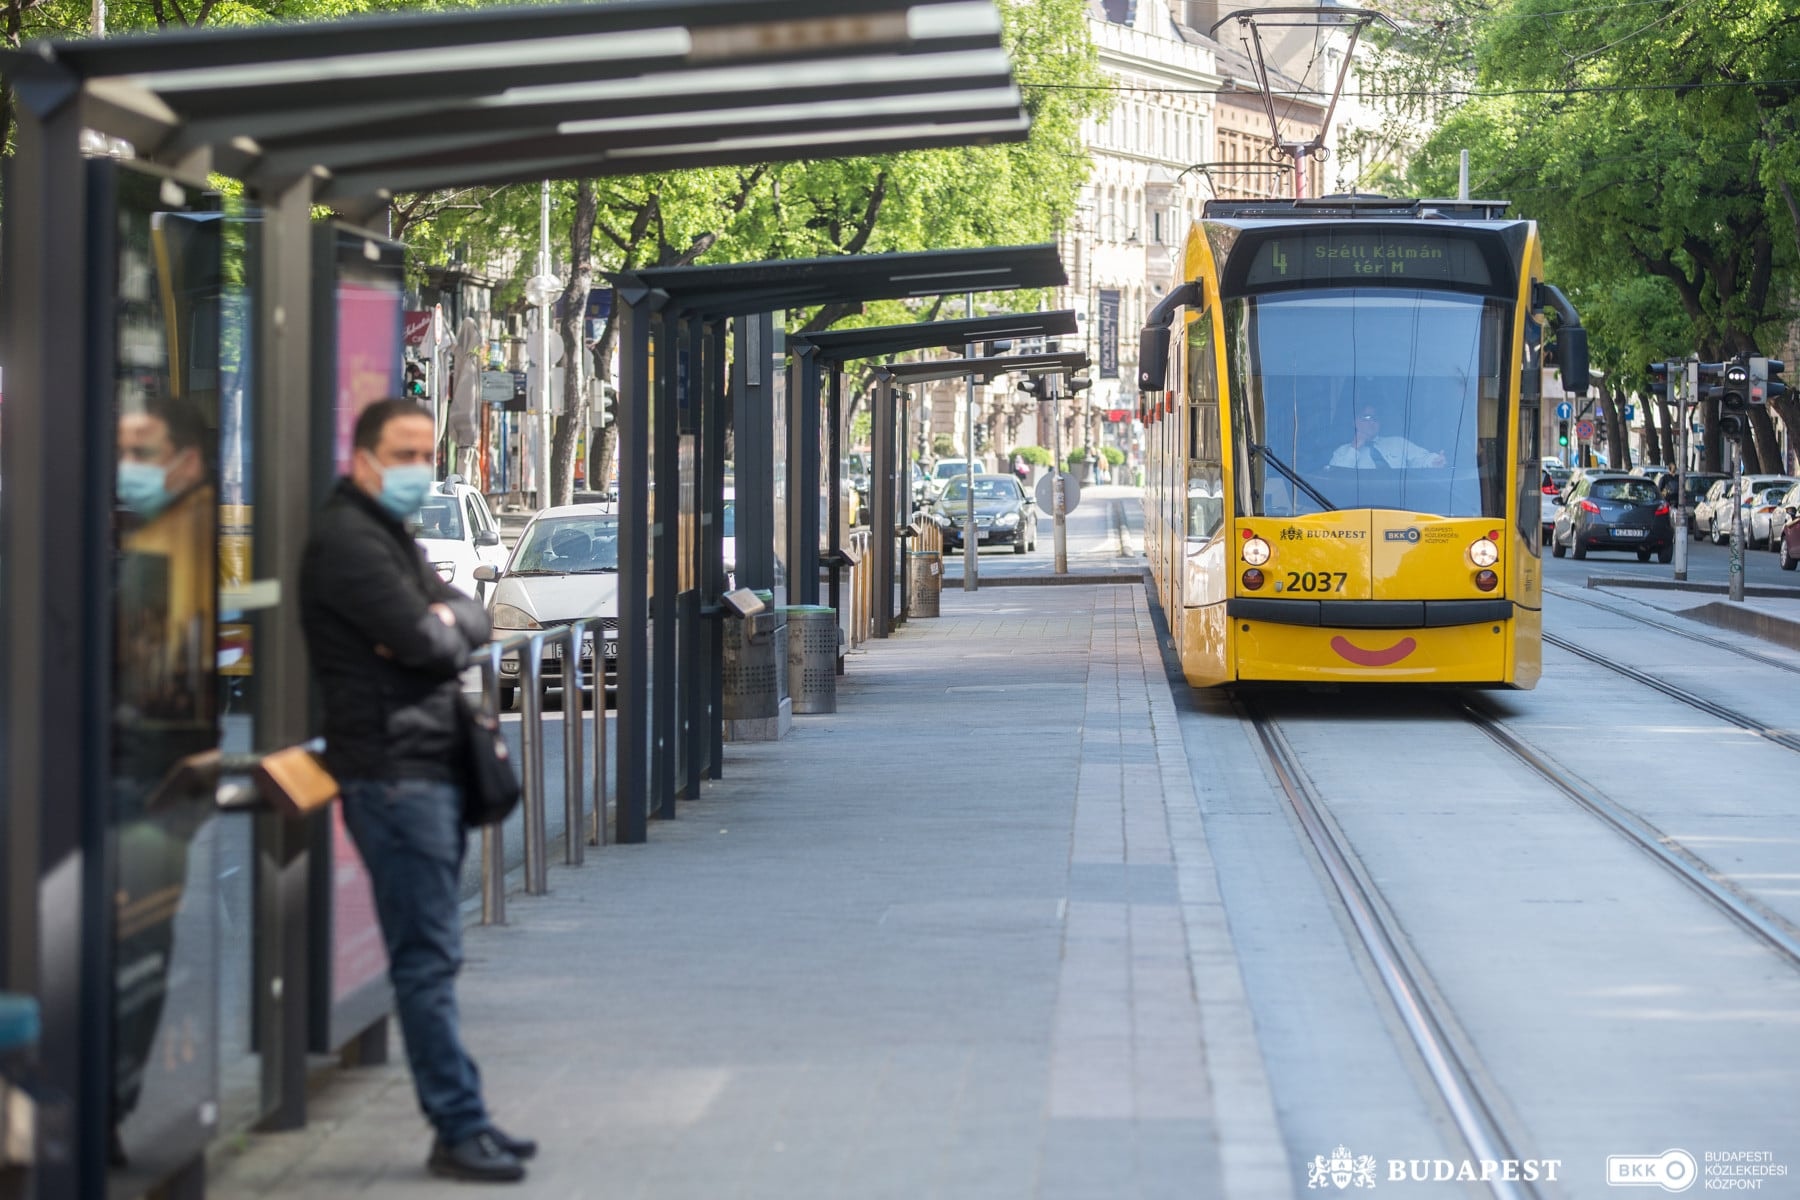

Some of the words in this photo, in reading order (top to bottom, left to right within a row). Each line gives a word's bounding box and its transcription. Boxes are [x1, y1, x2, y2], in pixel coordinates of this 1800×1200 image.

[1272, 241, 1288, 275] 4
[1315, 244, 1367, 258] Széll
[1373, 243, 1442, 258] Kálmán
[1353, 260, 1385, 273] tér
[1391, 261, 1404, 273] M
[1307, 530, 1367, 539] BUDAPEST
[1286, 571, 1348, 593] 2037
